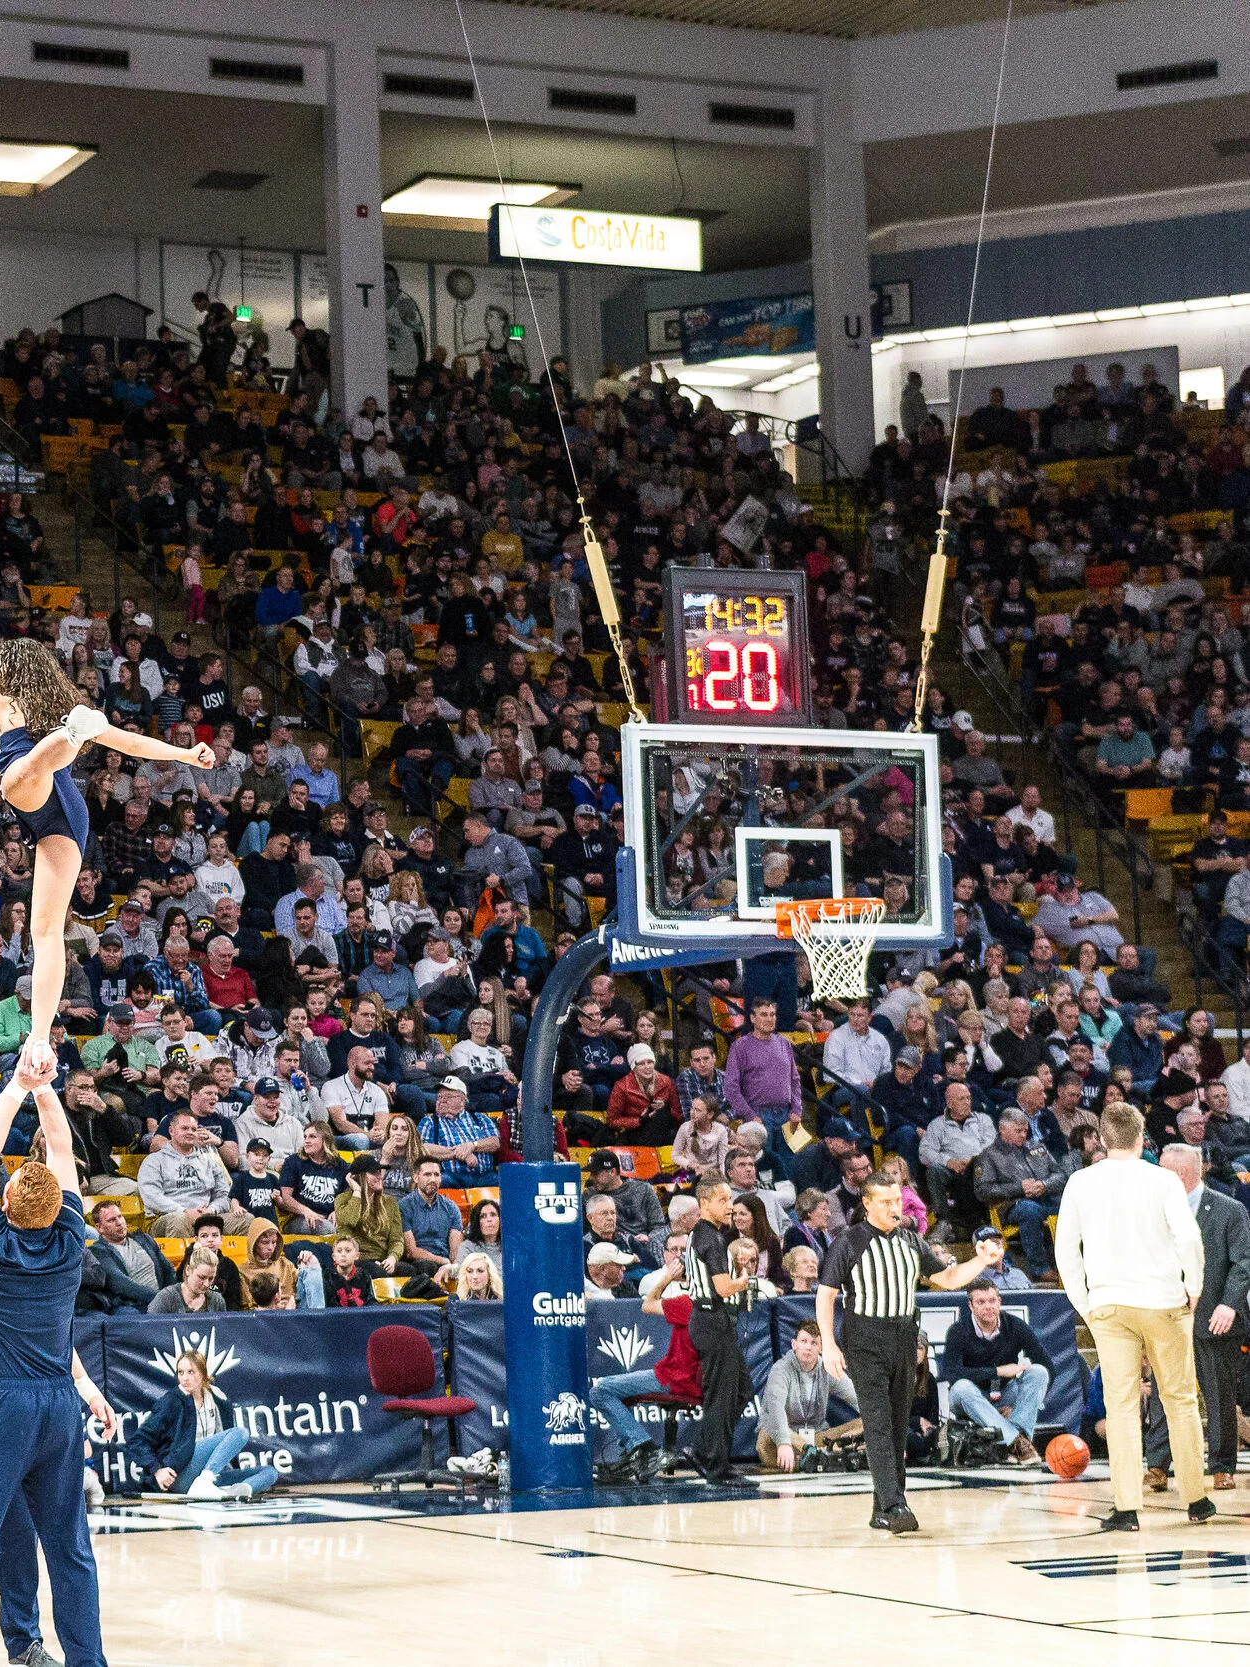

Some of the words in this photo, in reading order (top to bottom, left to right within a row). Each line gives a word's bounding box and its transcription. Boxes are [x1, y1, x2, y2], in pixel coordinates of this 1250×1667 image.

[356, 283, 375, 308] T
[844, 315, 861, 340] U
[704, 595, 785, 637] 14:32
[704, 641, 779, 712] 20
[203, 691, 225, 710] USU
[649, 922, 680, 931] SPALDING
[534, 1194, 579, 1210] STATE
[532, 1291, 586, 1315] Guild
[549, 1433, 586, 1446] AGGIES
